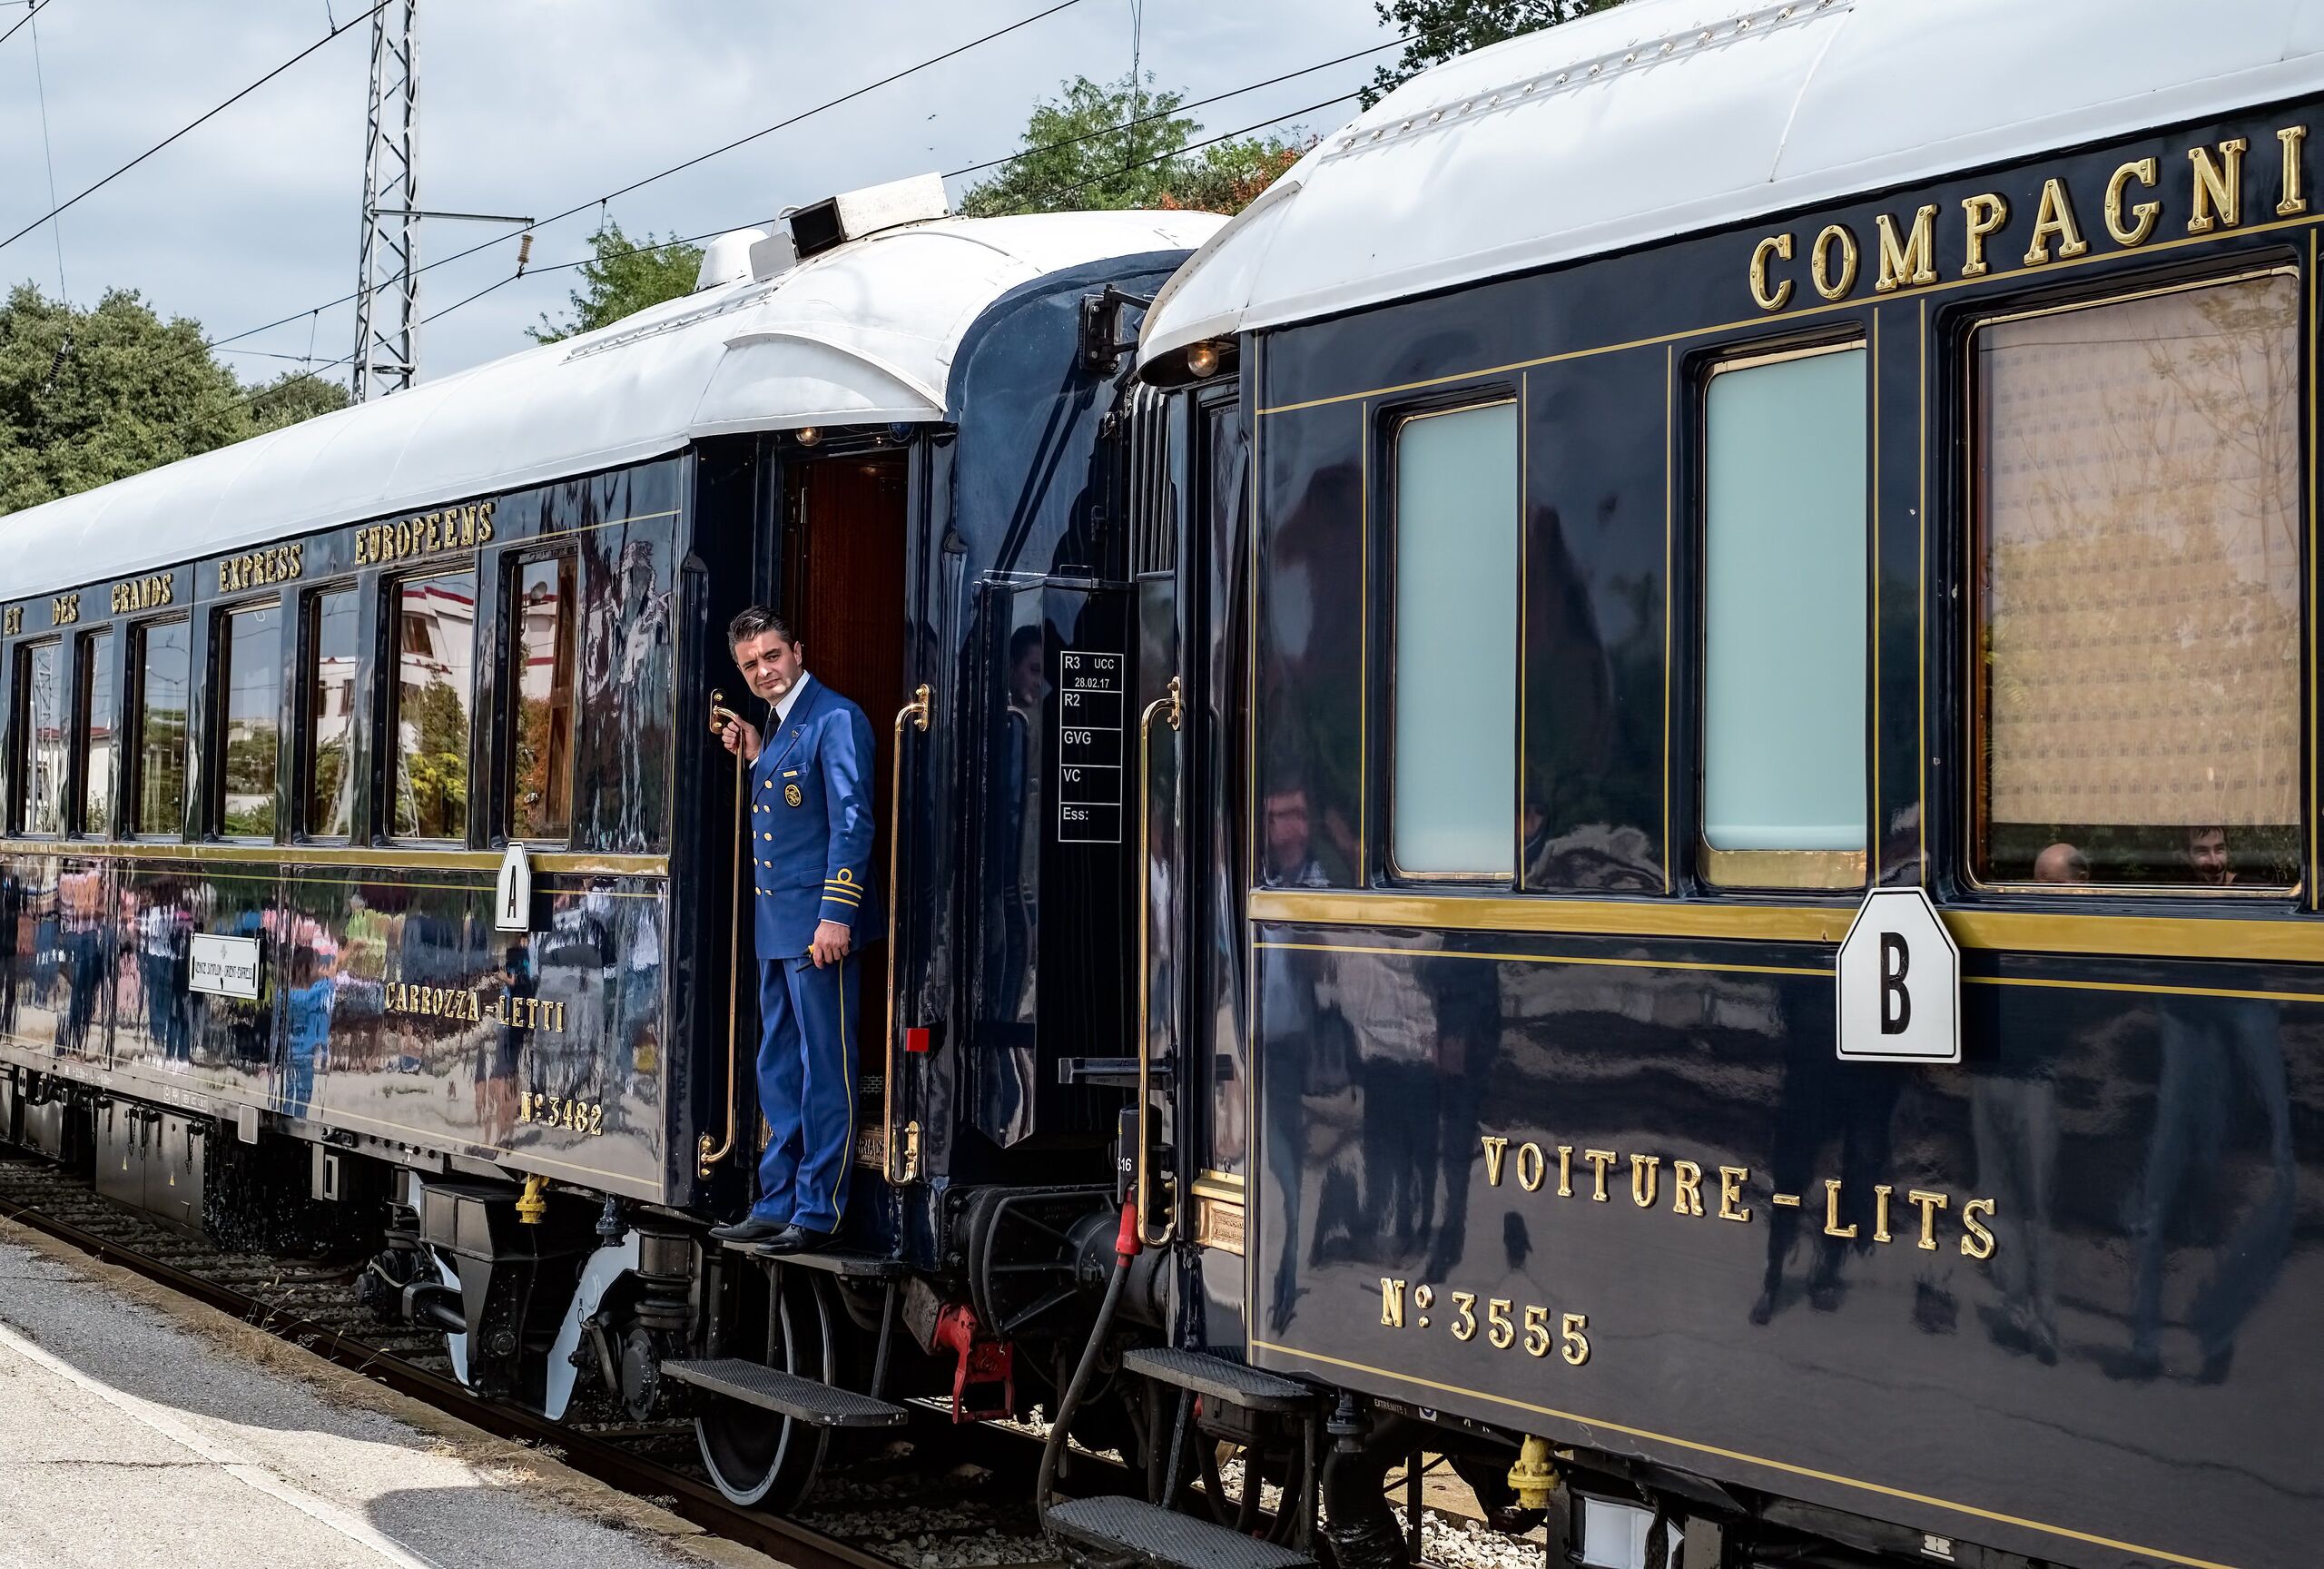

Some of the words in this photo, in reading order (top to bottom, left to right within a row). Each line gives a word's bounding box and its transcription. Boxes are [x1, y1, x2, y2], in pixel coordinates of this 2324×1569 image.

[1748, 124, 2307, 311] COMPAGNI
[5, 607, 23, 635] ET
[52, 594, 79, 626] DES
[111, 573, 172, 614] GRANDS
[219, 544, 302, 592] EXPRESS
[355, 503, 494, 565] EUROPEENS
[1065, 656, 1080, 669] R3
[1094, 658, 1115, 670] UCC
[1075, 677, 1109, 688] 28.02.17
[1064, 694, 1080, 706] R2
[1064, 731, 1091, 745] GVG
[1063, 769, 1081, 783] VC
[1063, 806, 1089, 821] Ess:
[507, 865, 517, 918] A
[1880, 932, 1911, 1035] B
[548, 1096, 604, 1136] 3482
[1451, 1291, 1590, 1366] 3555
